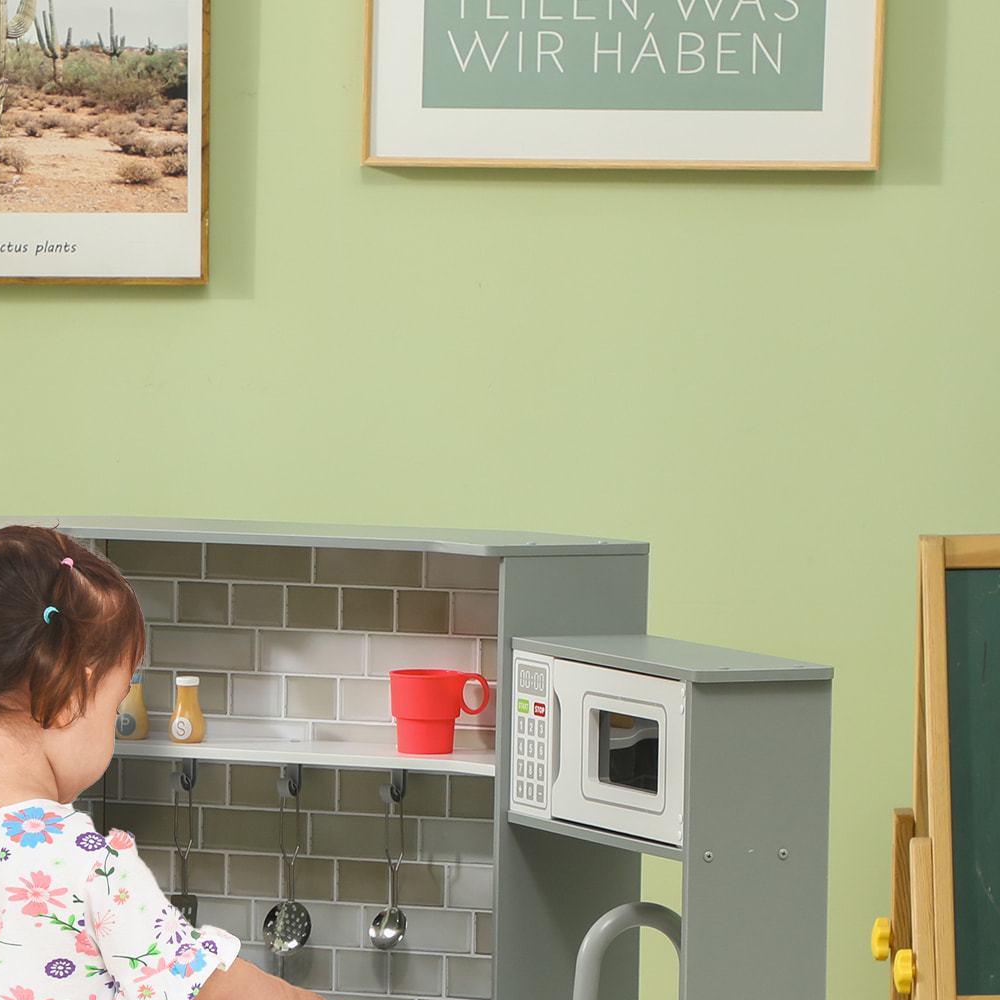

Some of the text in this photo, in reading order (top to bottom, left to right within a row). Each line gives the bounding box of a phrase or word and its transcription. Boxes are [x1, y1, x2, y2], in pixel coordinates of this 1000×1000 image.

[447, 30, 783, 75] WIR HABEN
[35, 240, 78, 256] plants
[535, 704, 546, 714] STOP
[120, 717, 130, 732] P
[176, 721, 186, 737] S
